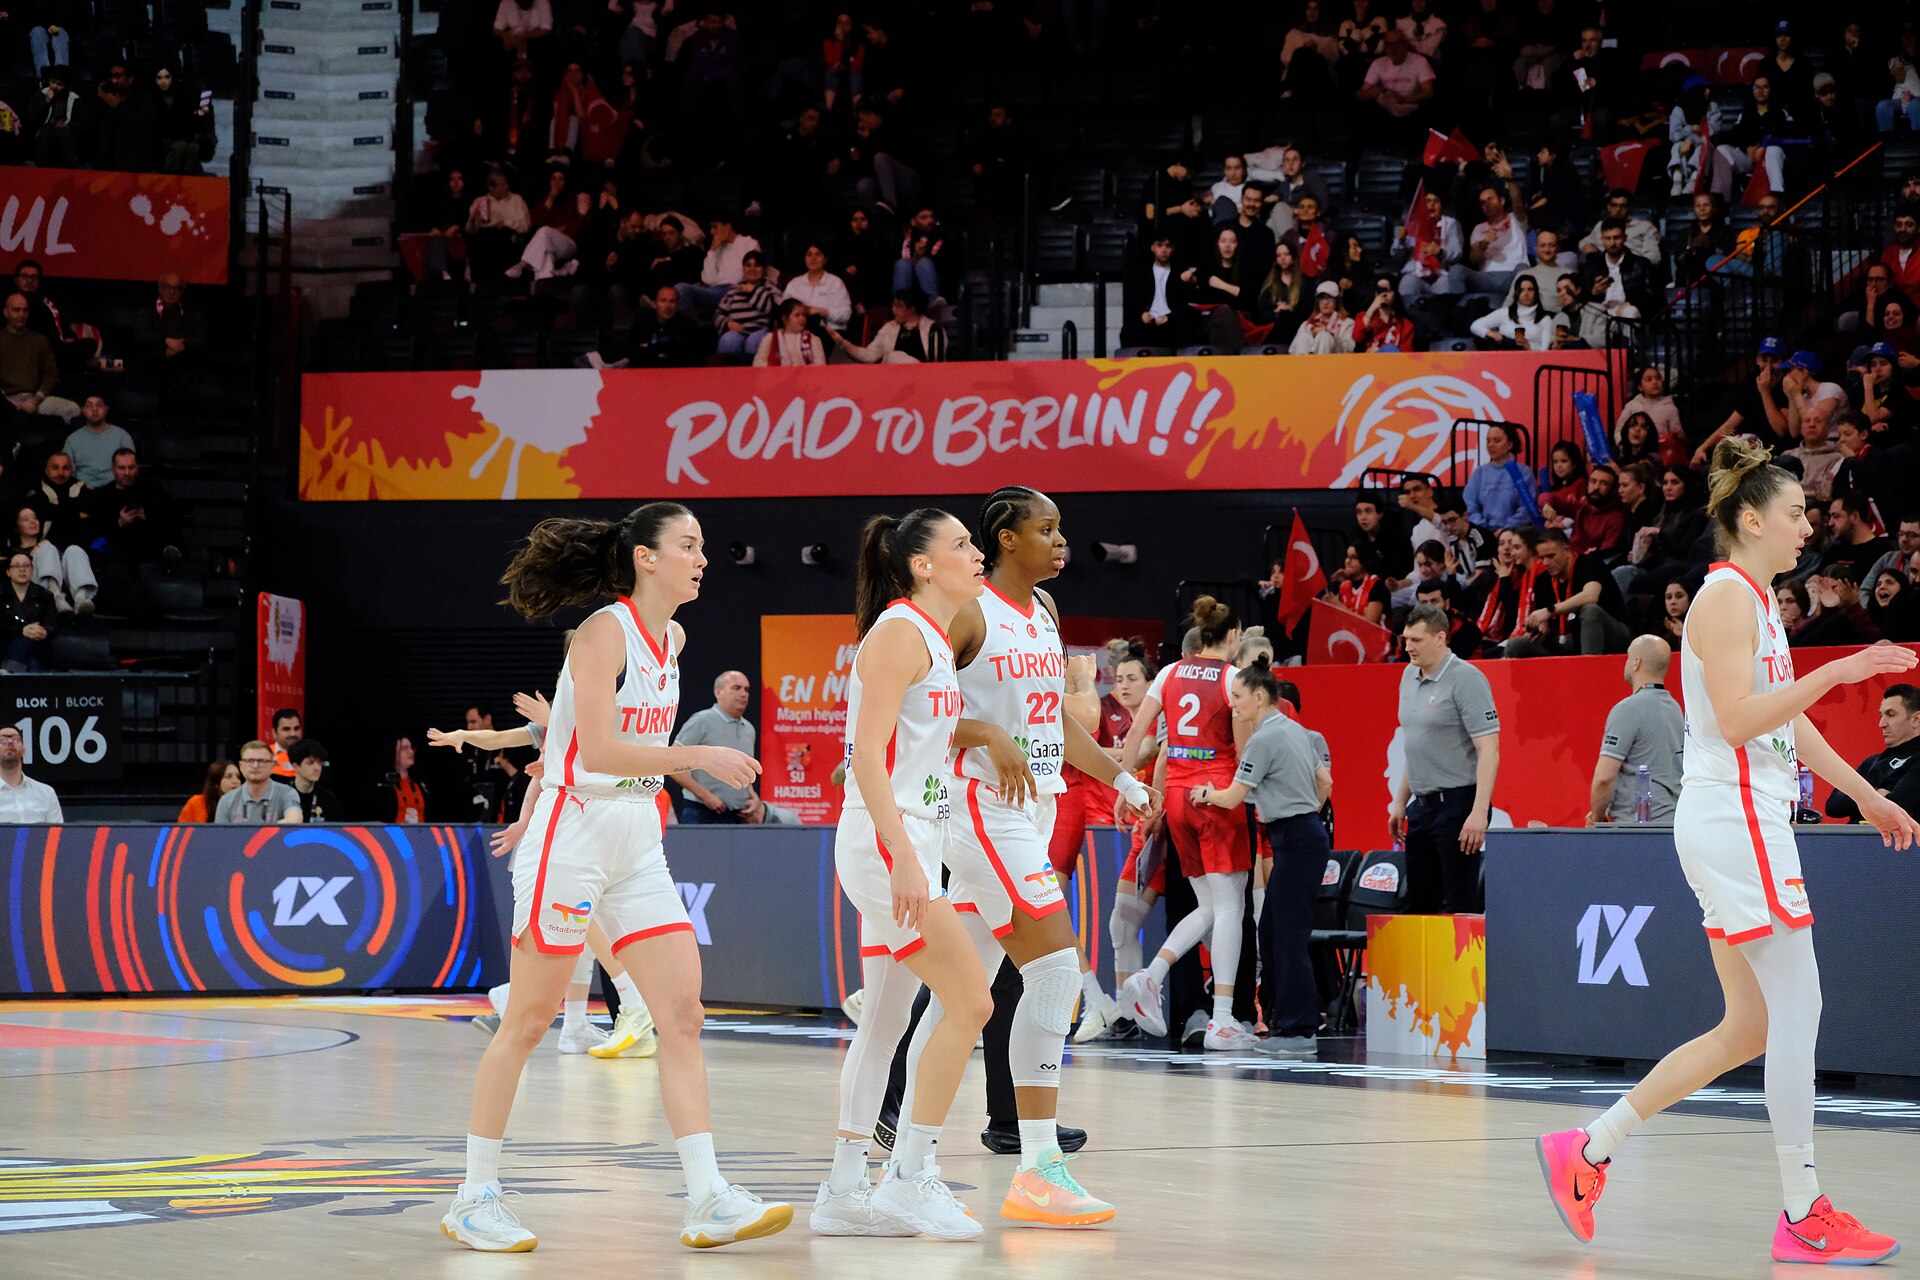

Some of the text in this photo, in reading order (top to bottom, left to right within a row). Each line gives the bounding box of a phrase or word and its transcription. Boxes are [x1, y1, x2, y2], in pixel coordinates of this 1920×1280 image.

[665, 396, 862, 485] ROAD
[871, 407, 925, 455] TO
[989, 646, 1066, 682] TÜRKİY
[16, 696, 105, 709] BLOK BLOCK
[780, 675, 816, 703] EN
[1026, 691, 1059, 725] 22
[814, 707, 847, 725] heyec
[1177, 693, 1201, 737] 2
[14, 715, 108, 765] 106
[272, 876, 354, 926] 1X
[1576, 904, 1655, 986] 1X
